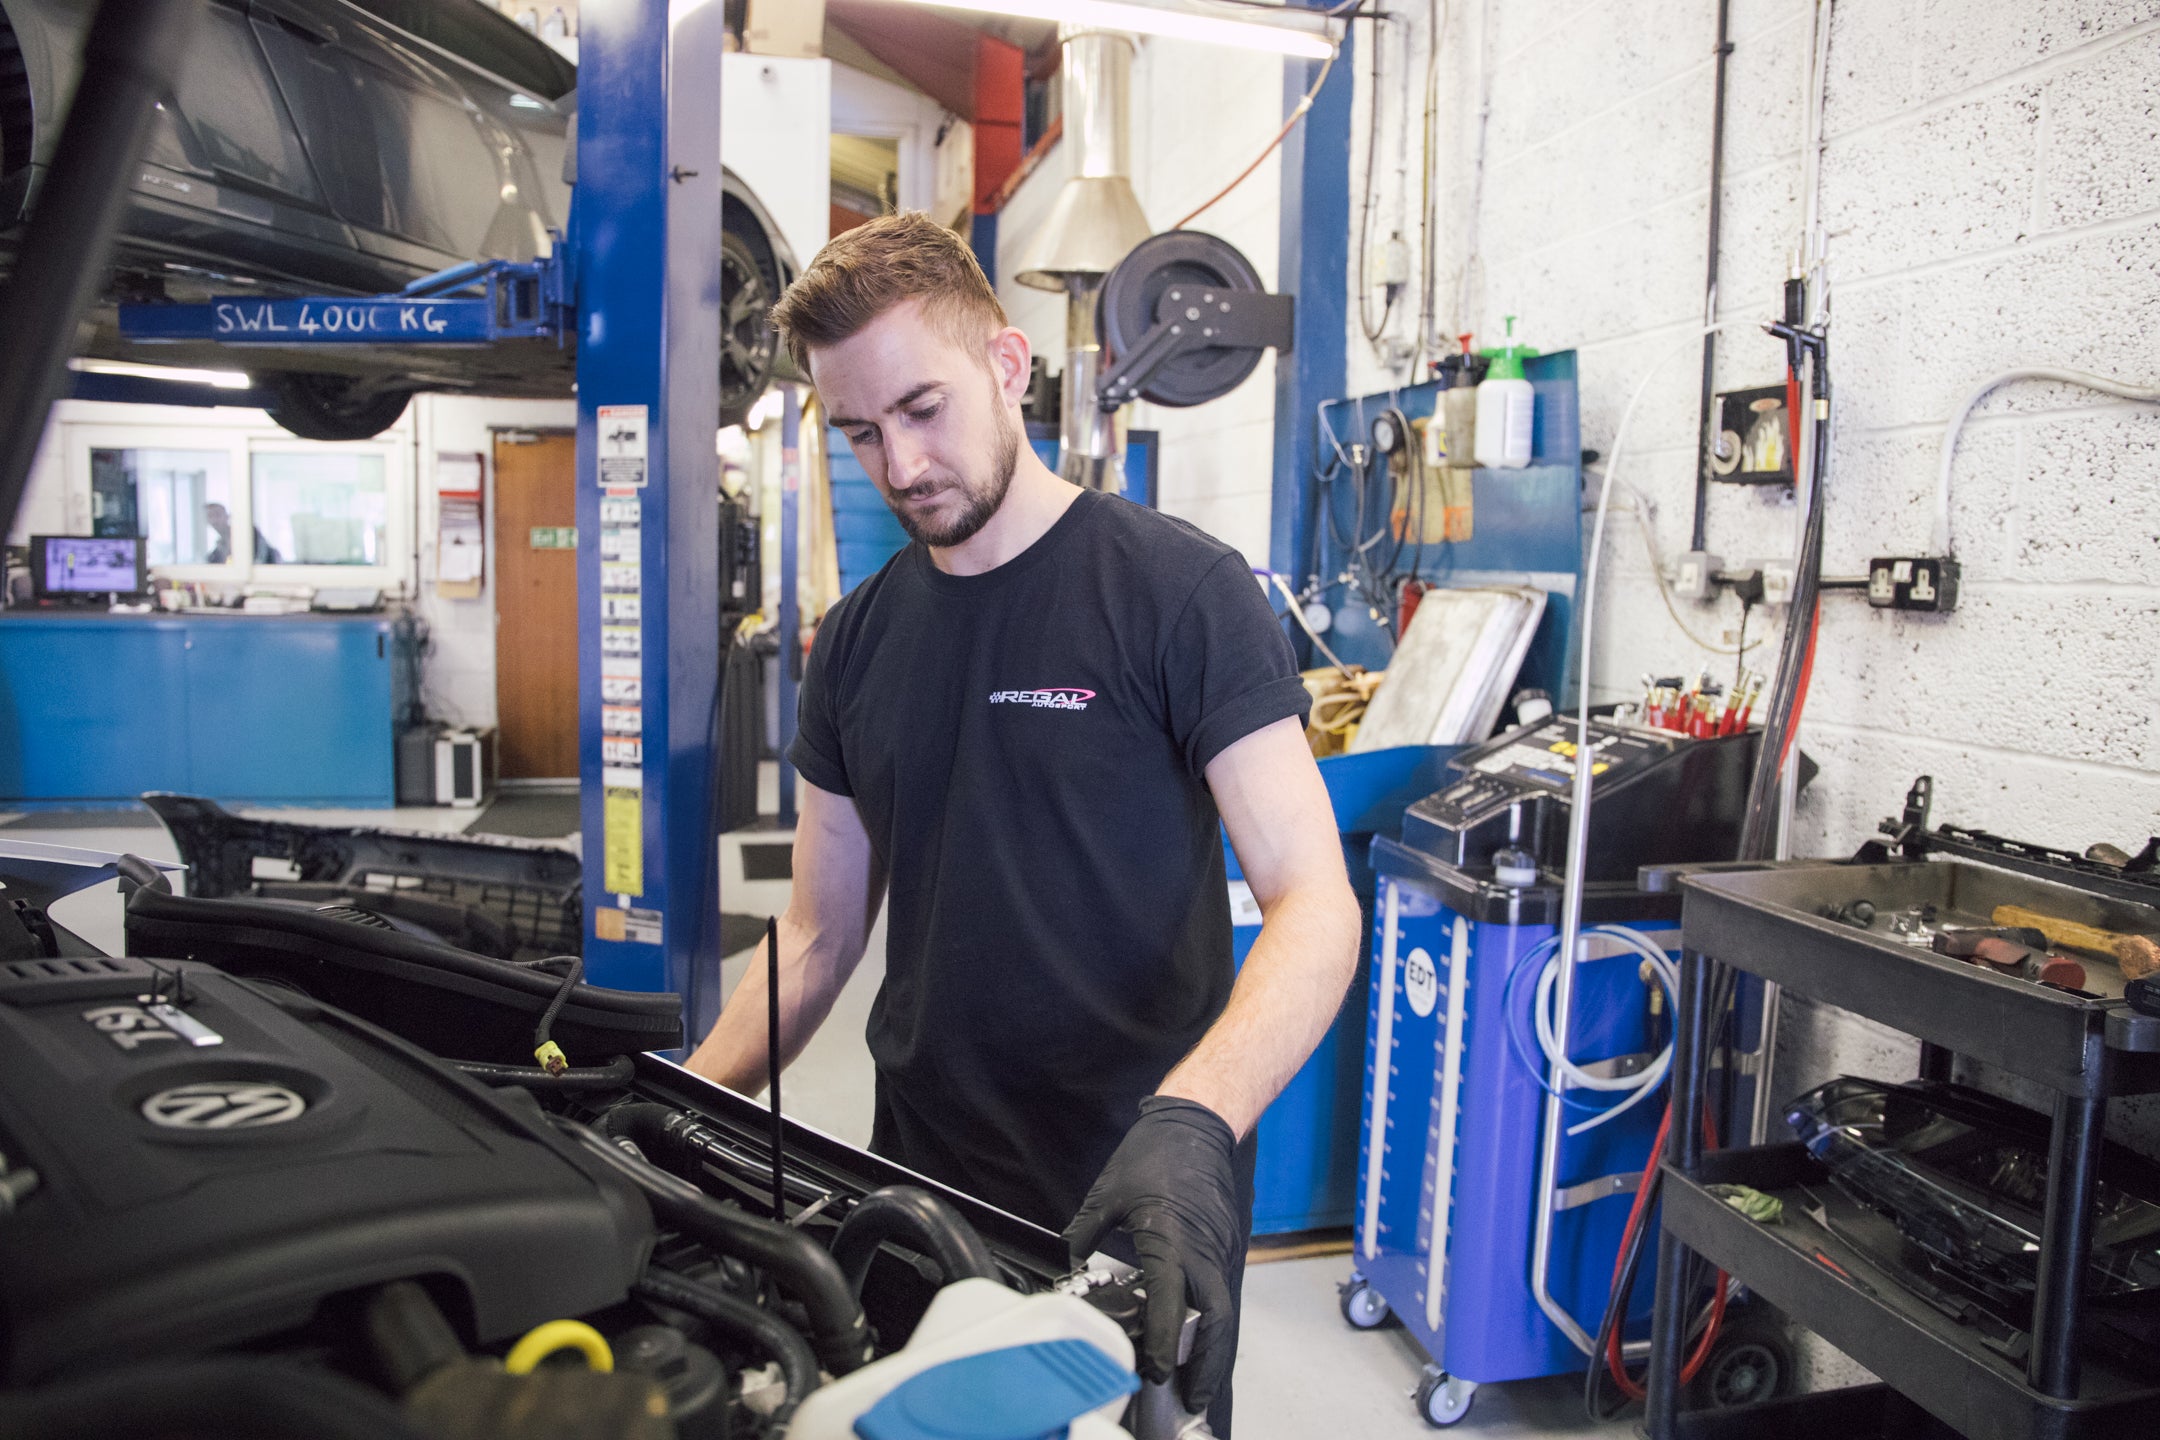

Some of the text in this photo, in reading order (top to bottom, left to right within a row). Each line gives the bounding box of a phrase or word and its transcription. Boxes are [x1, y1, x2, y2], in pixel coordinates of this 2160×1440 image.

[217, 303, 288, 333] SWL
[401, 306, 448, 334] KG
[1000, 691, 1086, 704] REGAL
[1032, 702, 1087, 710] AUTOSPORT
[1409, 961, 1435, 991] EDT
